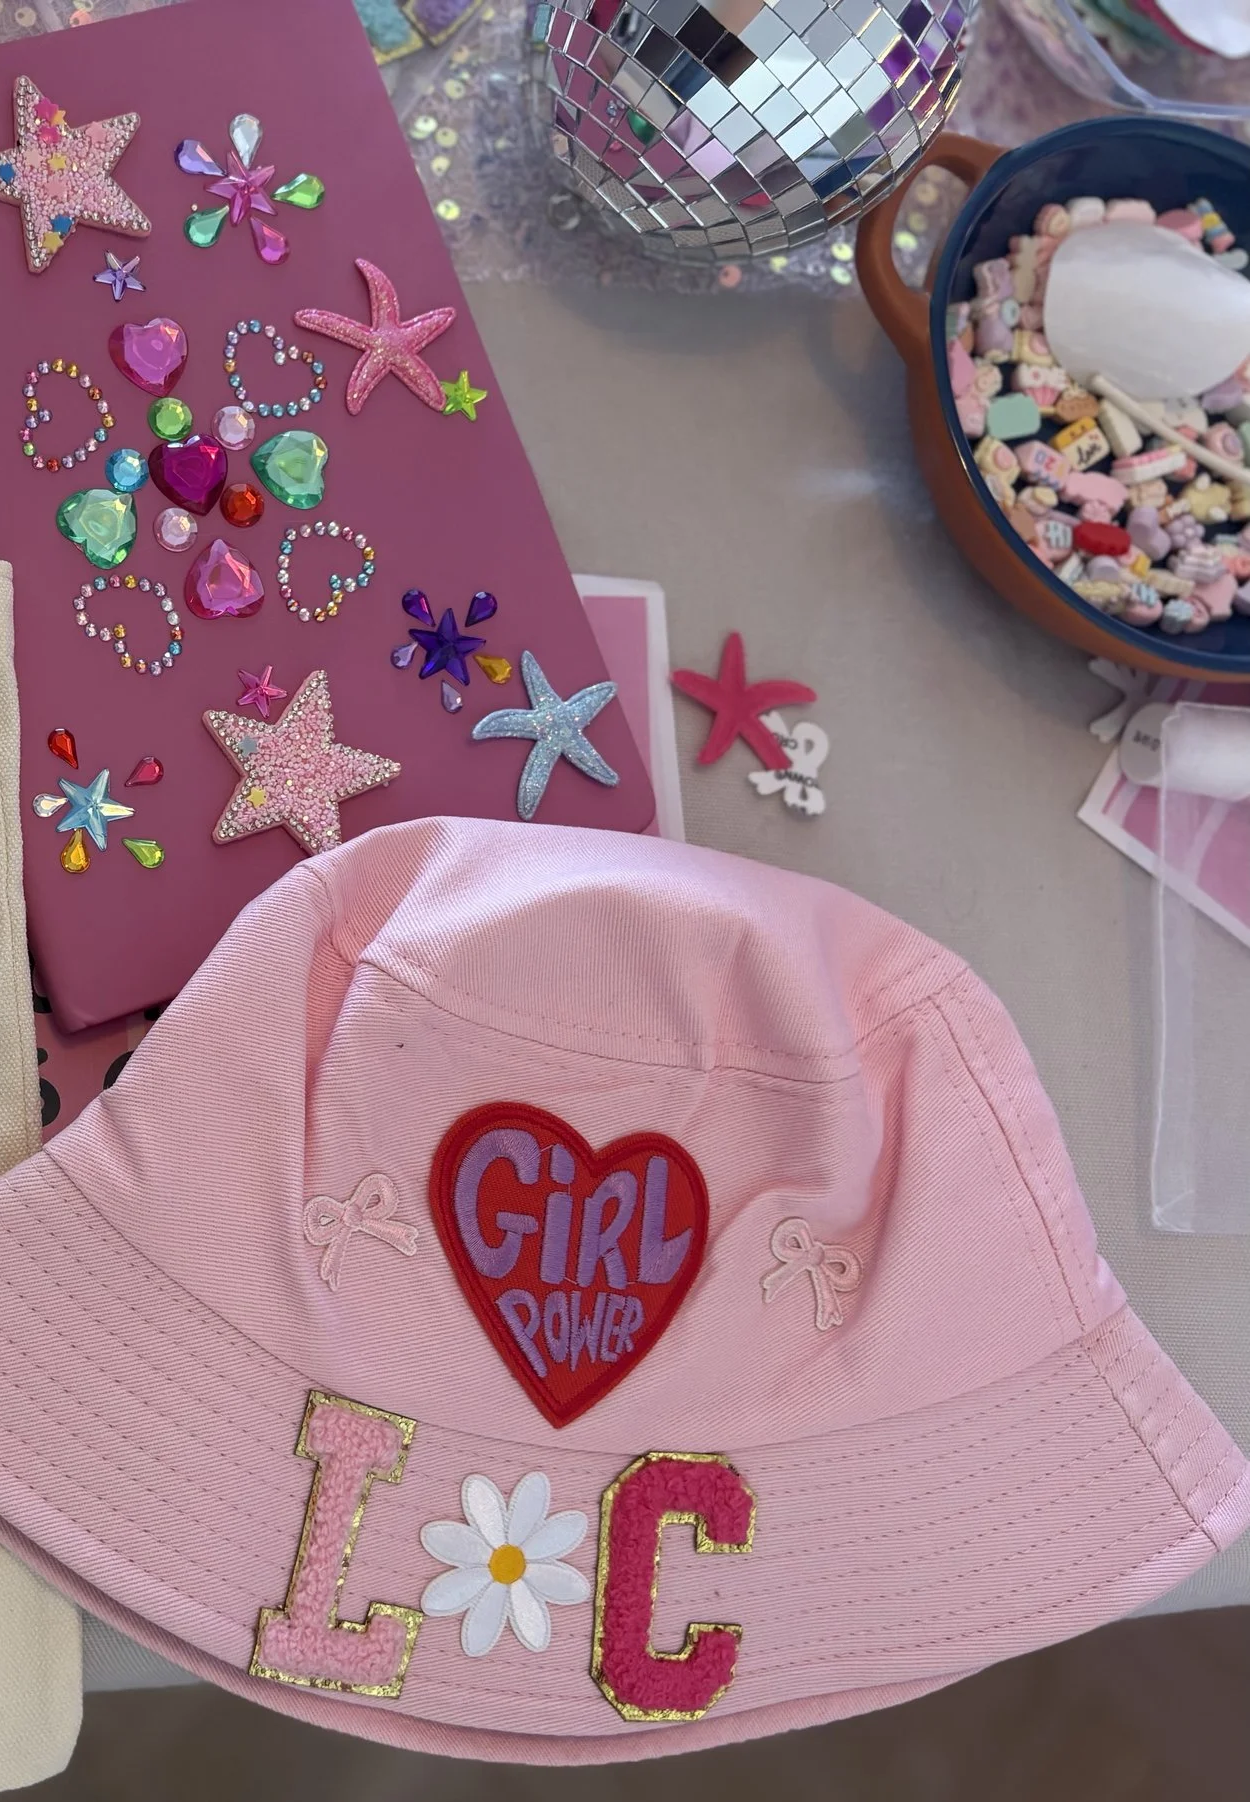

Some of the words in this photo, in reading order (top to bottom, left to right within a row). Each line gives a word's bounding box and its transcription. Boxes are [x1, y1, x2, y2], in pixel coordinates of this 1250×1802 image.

[495, 1288, 644, 1378] POWER
[250, 1389, 424, 1700] L
[590, 1451, 756, 1722] C
